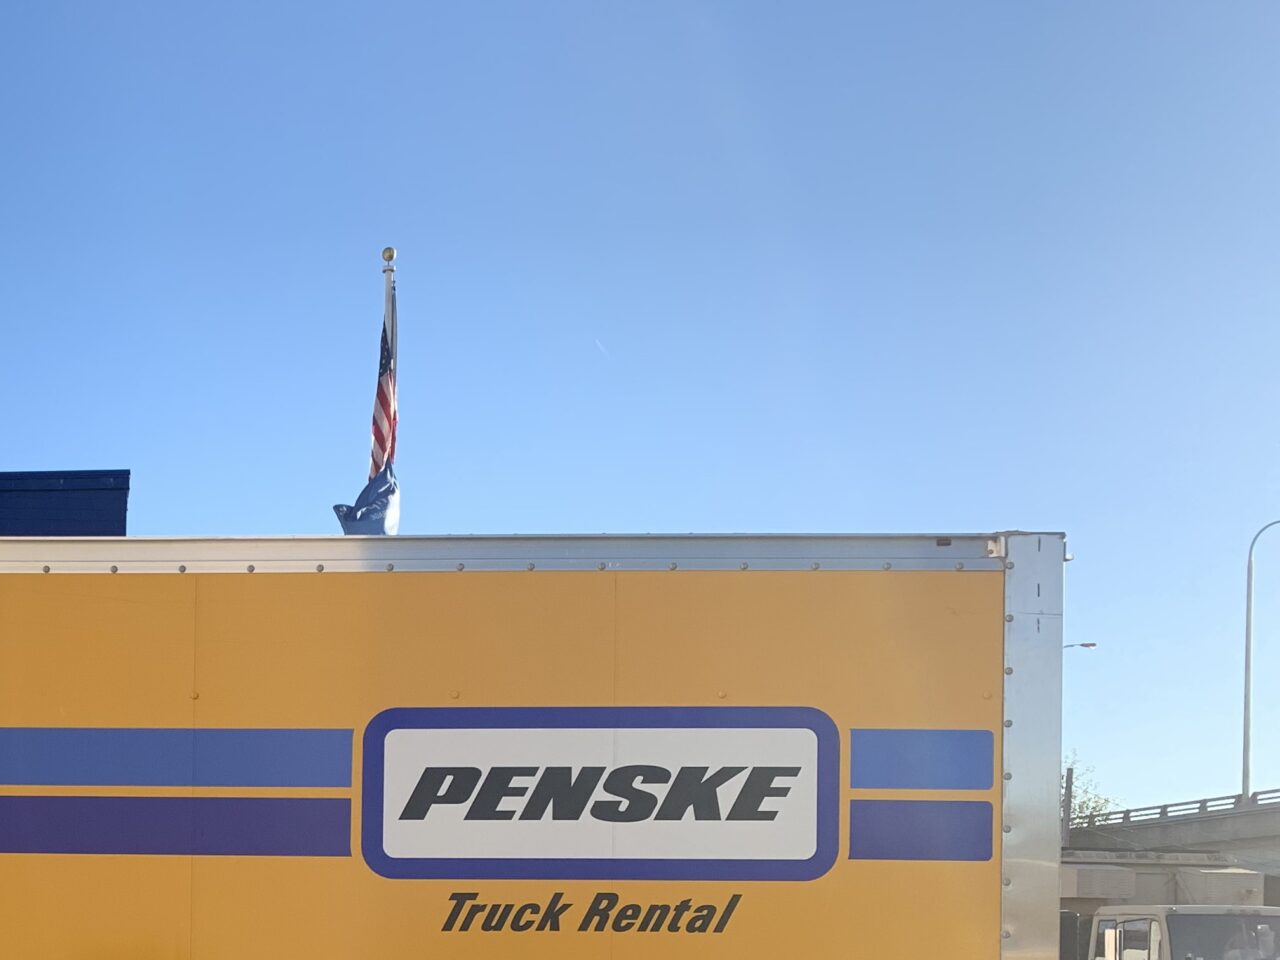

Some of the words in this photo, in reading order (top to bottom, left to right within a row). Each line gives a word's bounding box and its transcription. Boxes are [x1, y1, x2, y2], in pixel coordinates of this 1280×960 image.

[398, 764, 802, 823] PENSKE
[440, 892, 574, 933] Truck
[577, 892, 743, 934] Rental
